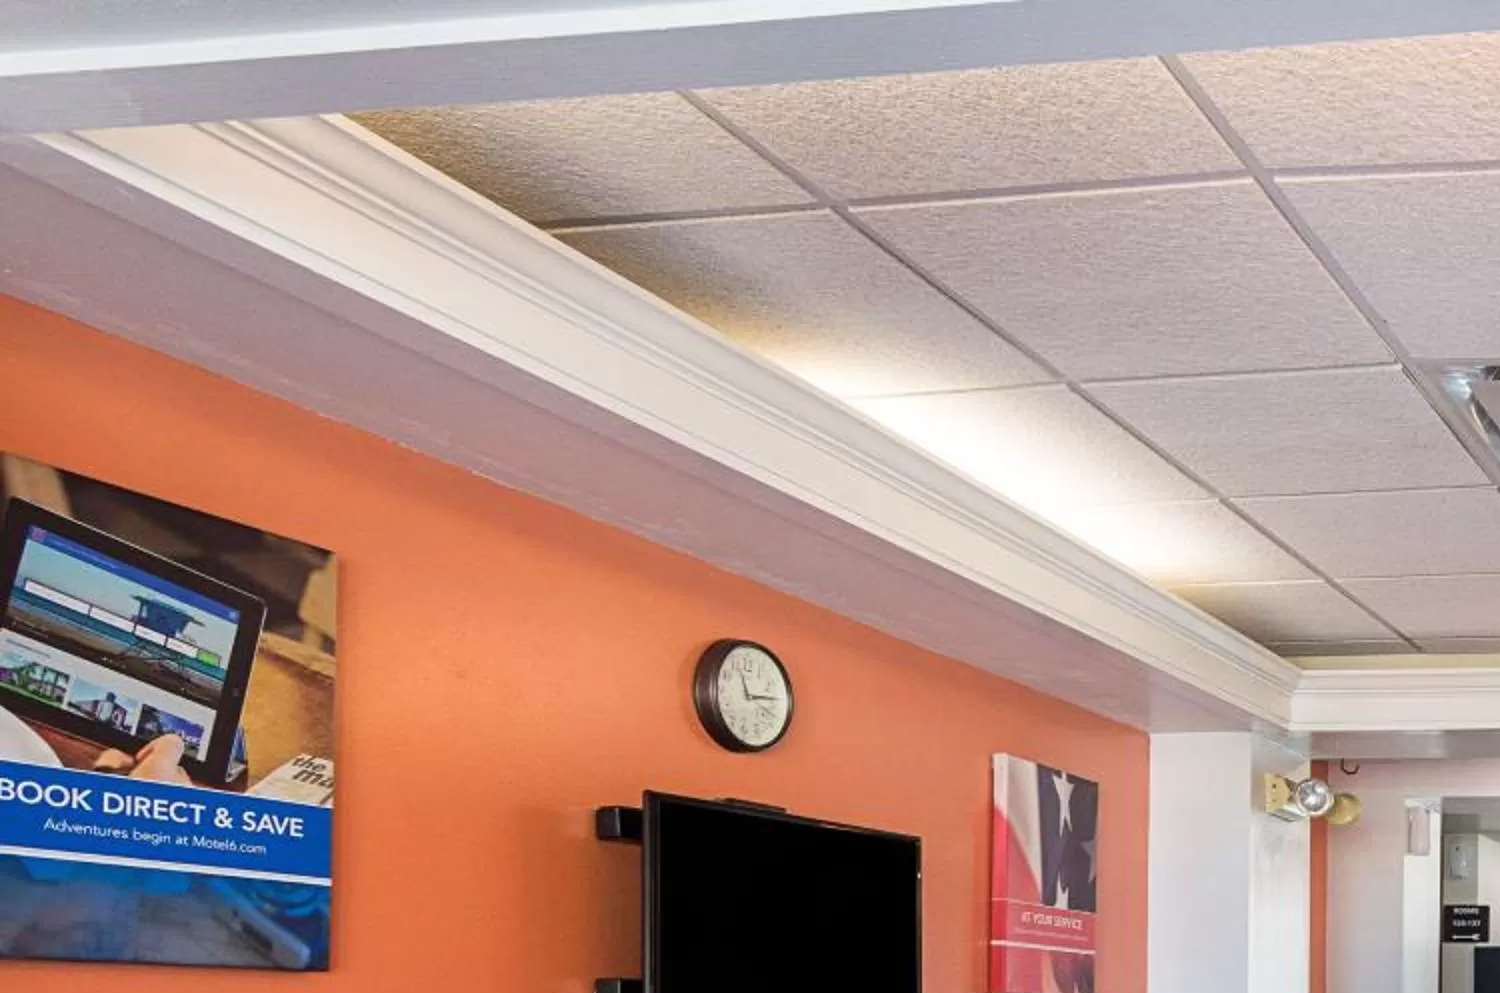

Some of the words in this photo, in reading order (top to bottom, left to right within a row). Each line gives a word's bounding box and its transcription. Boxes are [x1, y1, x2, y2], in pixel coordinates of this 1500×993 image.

[0, 777, 92, 811] BOOK
[103, 792, 206, 825] DIRECT
[213, 807, 233, 829] &
[242, 811, 304, 837] SAVE
[43, 817, 129, 839] Adventures
[133, 828, 171, 846] begin
[175, 834, 189, 846] at
[192, 835, 267, 854] Motel6.com
[1054, 915, 1083, 930] SERVICE
